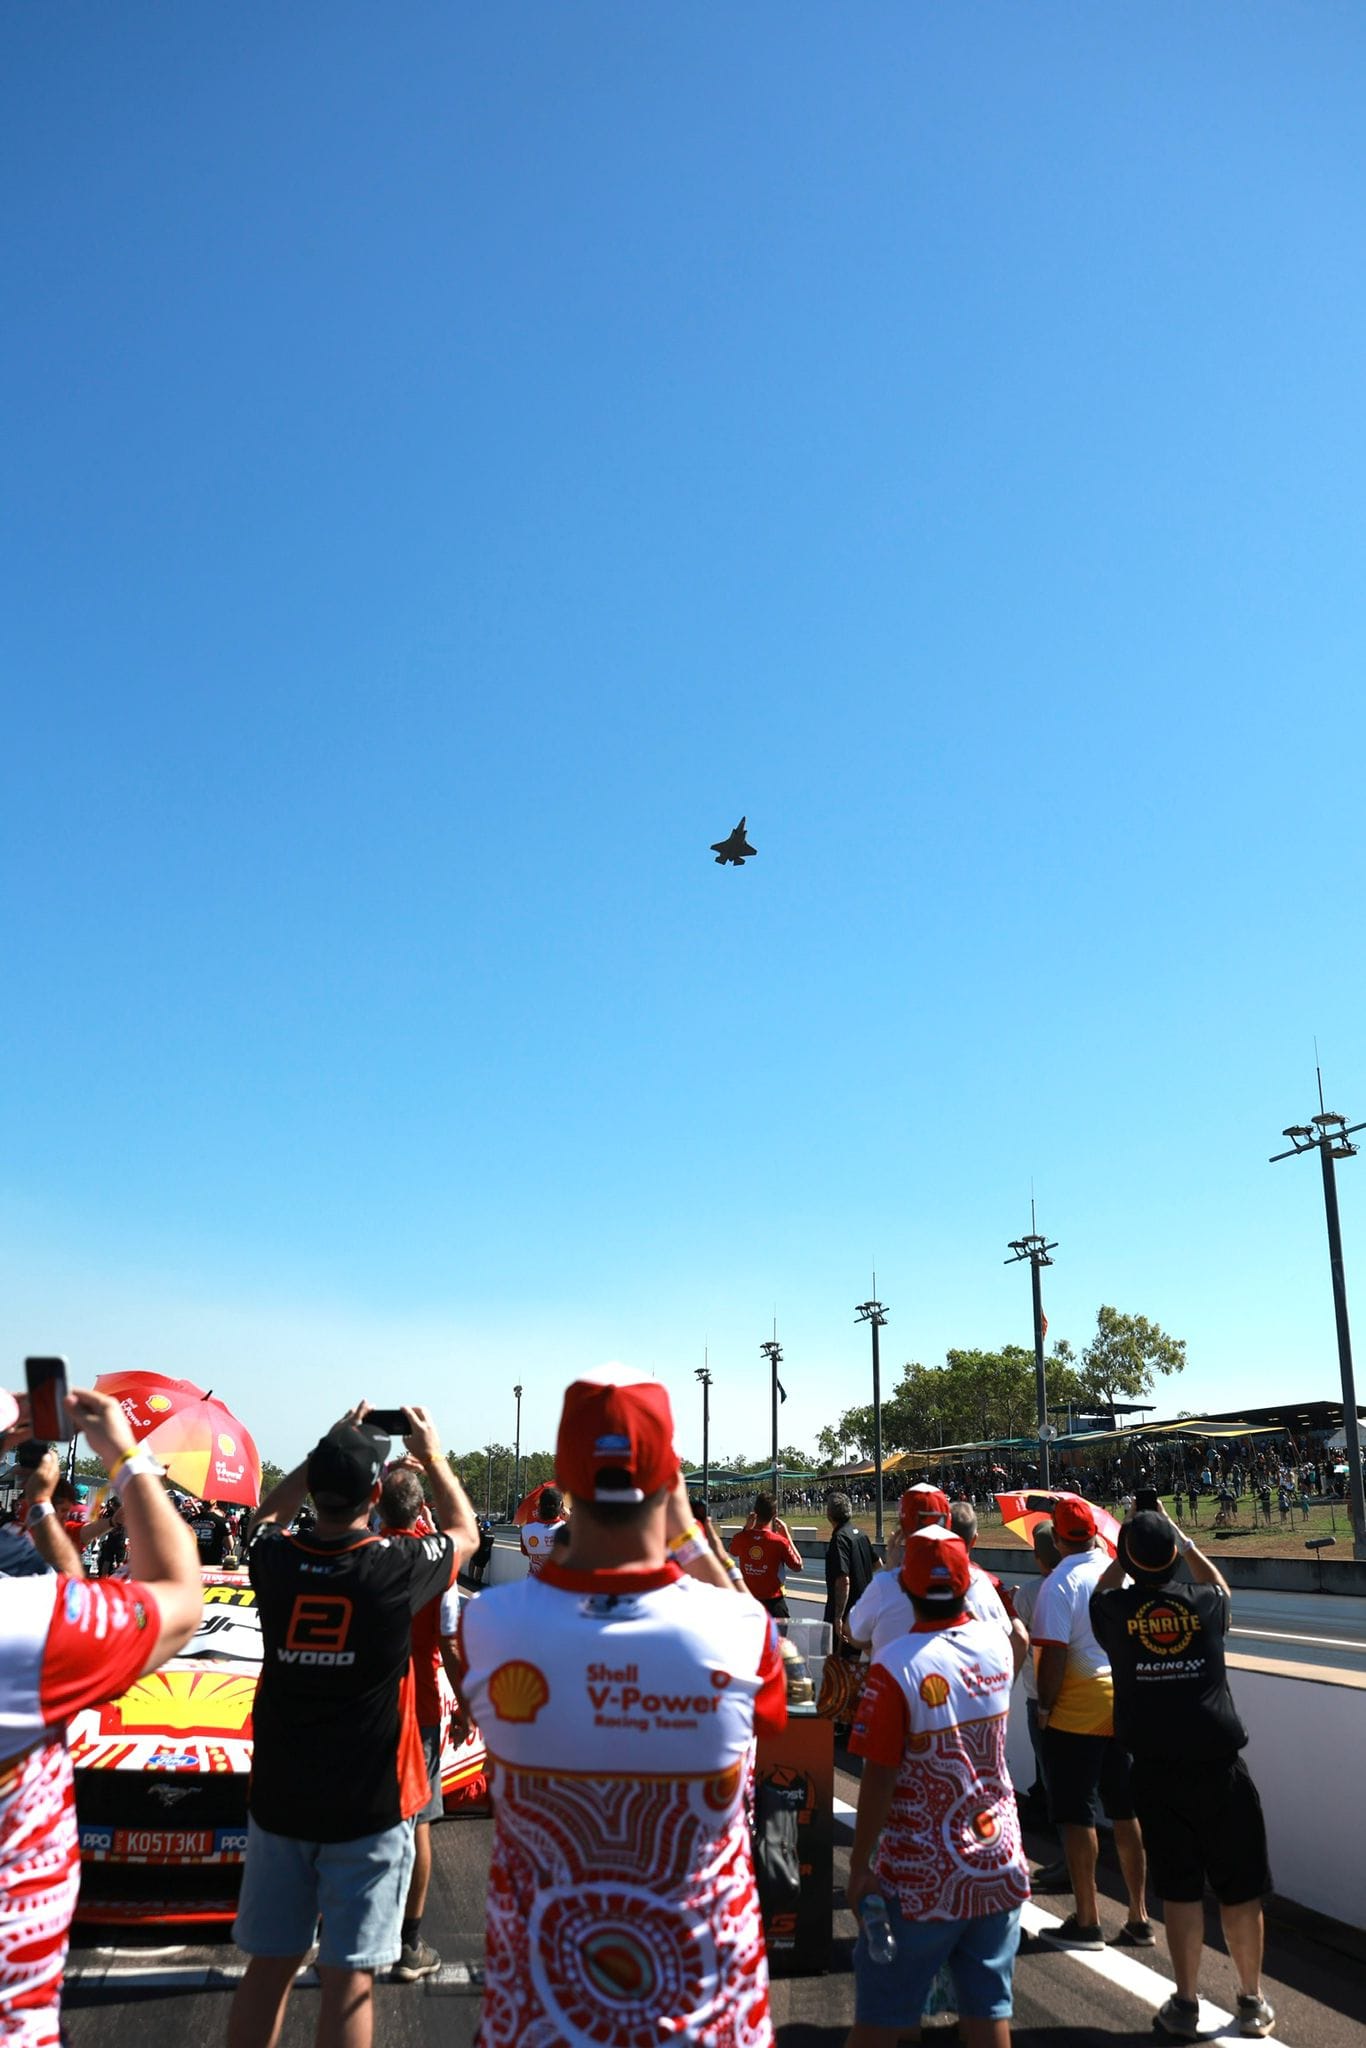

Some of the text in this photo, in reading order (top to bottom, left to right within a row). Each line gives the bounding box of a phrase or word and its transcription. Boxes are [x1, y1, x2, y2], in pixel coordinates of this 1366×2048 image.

[1127, 1615, 1201, 1635] PENRITE
[586, 1663, 638, 1683] Shell
[1136, 1661, 1184, 1671] RACING
[586, 1685, 720, 1714] V-Power
[594, 1715, 698, 1731] Racing Team
[82, 1833, 112, 1848] PPQ
